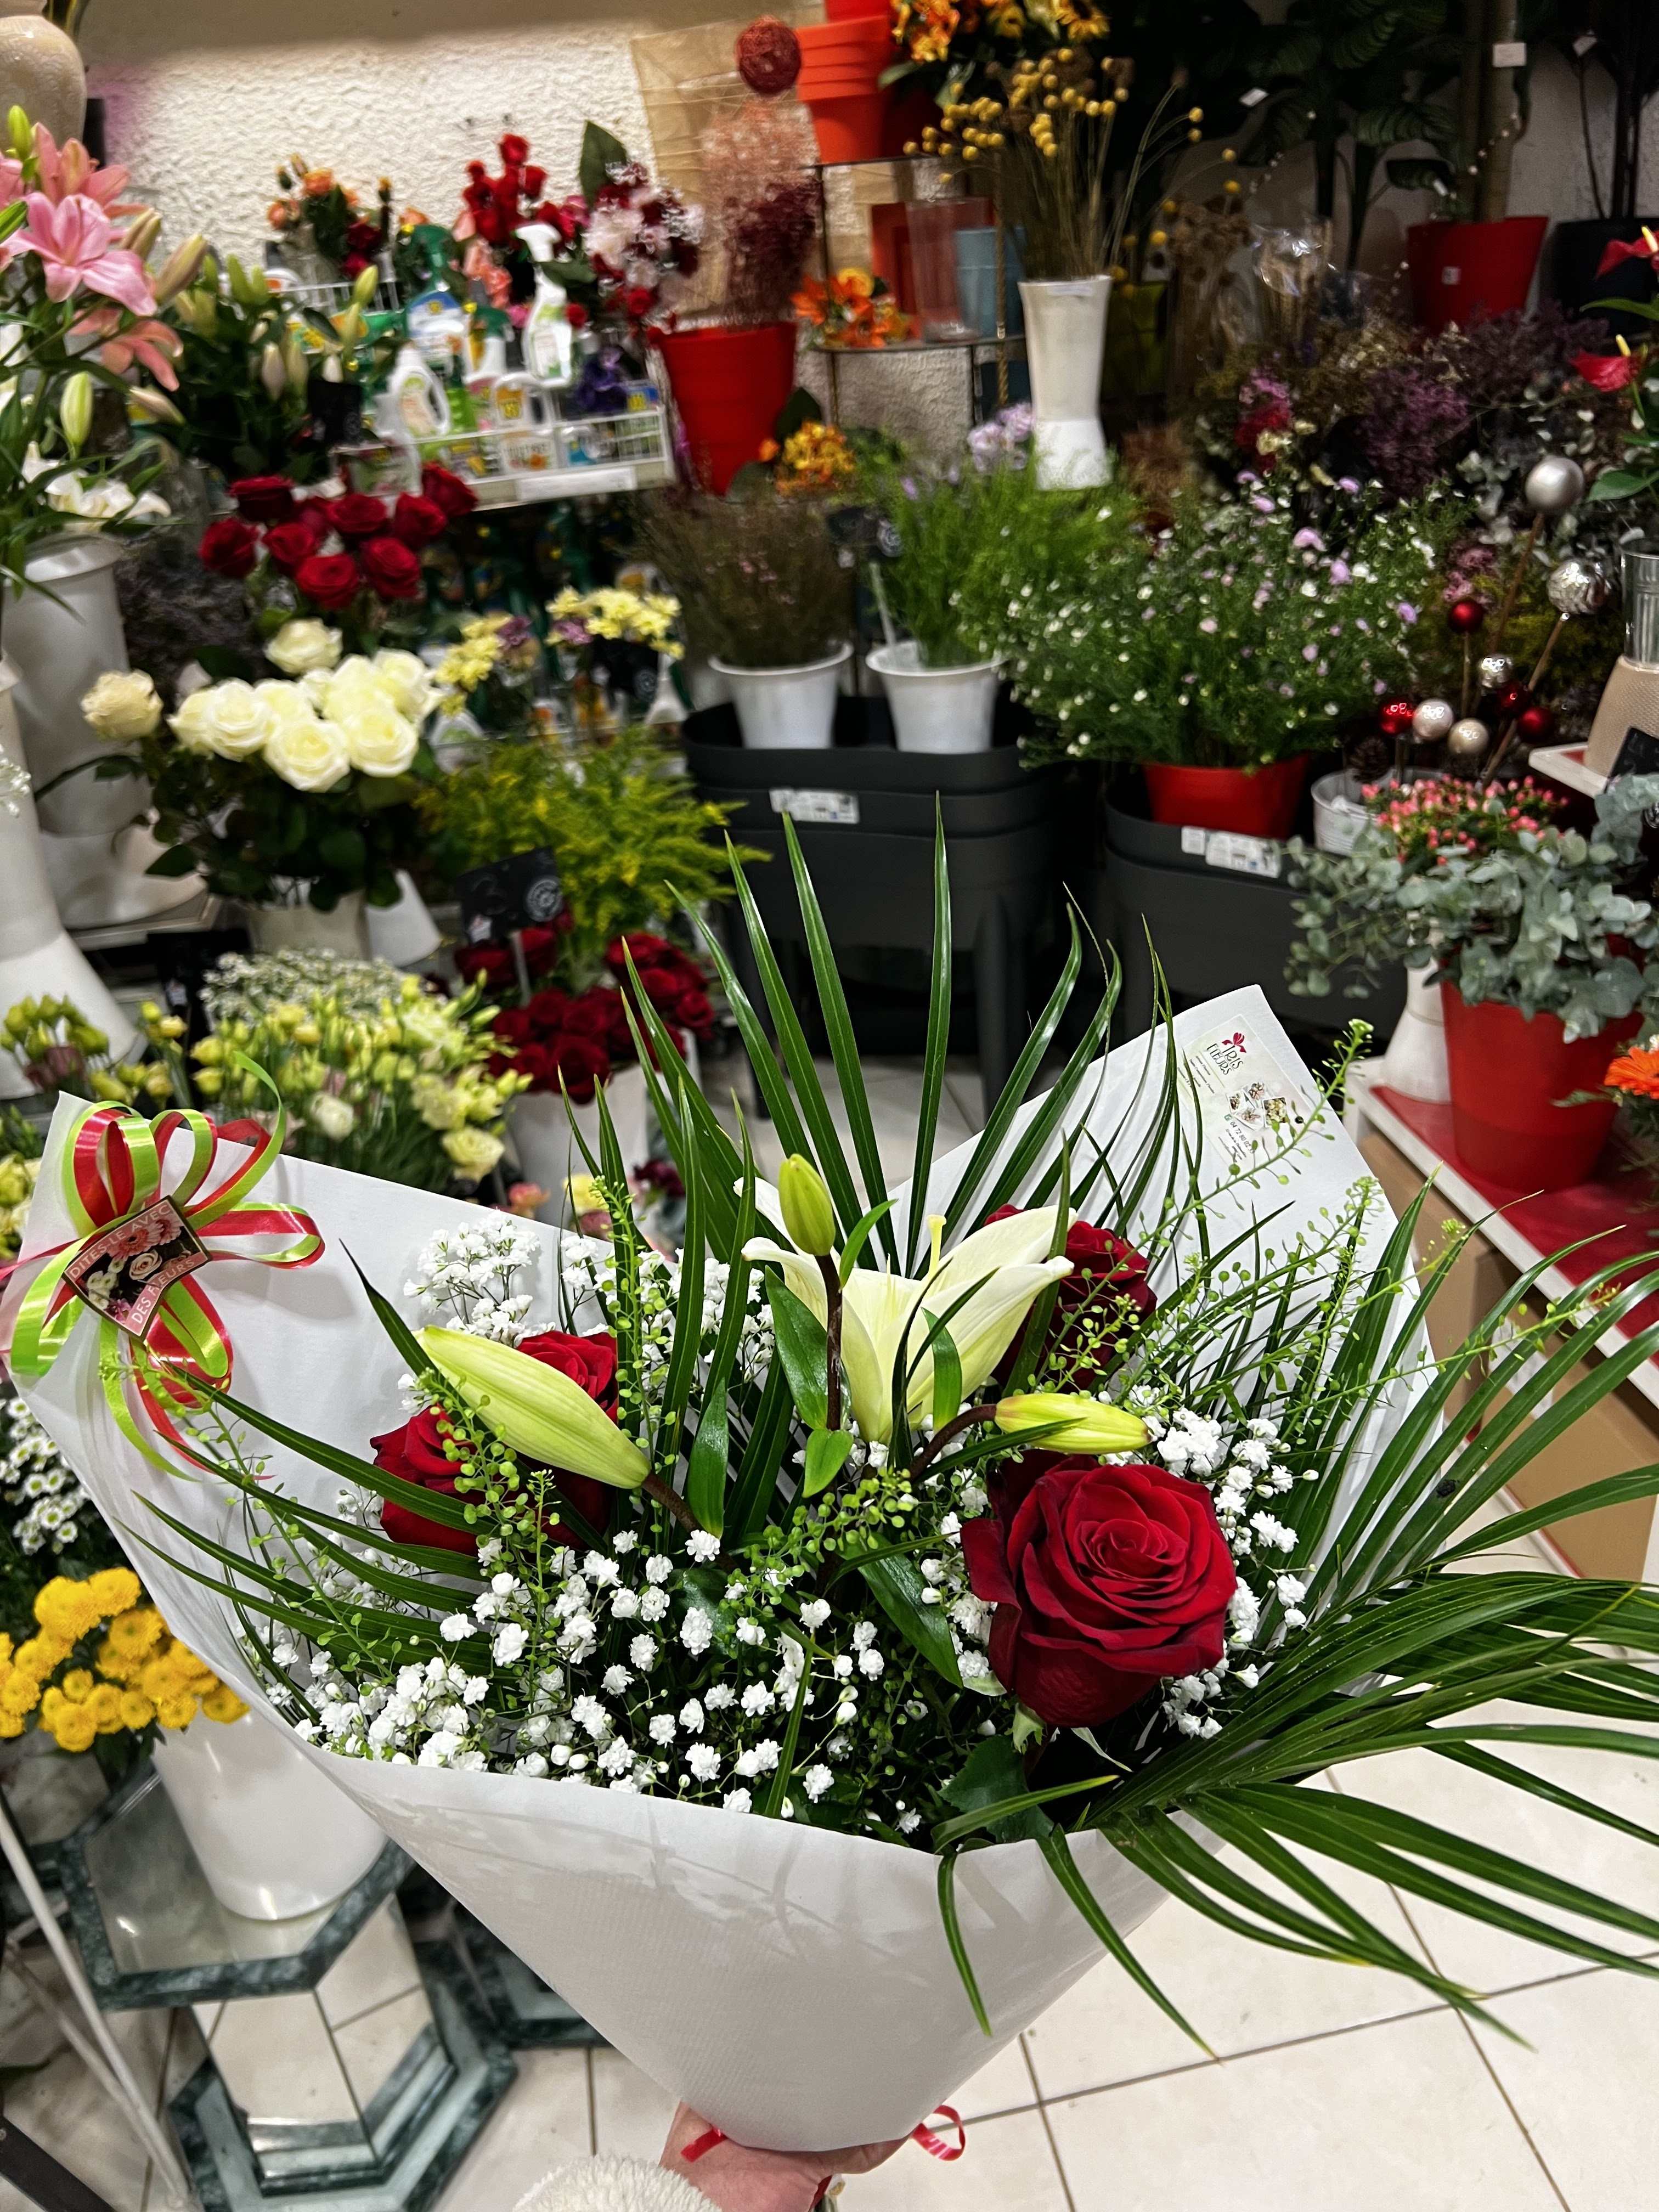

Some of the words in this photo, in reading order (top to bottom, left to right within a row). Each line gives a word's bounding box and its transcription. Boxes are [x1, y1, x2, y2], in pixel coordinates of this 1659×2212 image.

[1206, 1042, 1233, 1075] FLEURS
[1222, 1045, 1244, 1070] IRIS
[70, 1229, 126, 1279] DITES-LE
[131, 1204, 171, 1233] AVEC
[131, 1296, 151, 1324] DES
